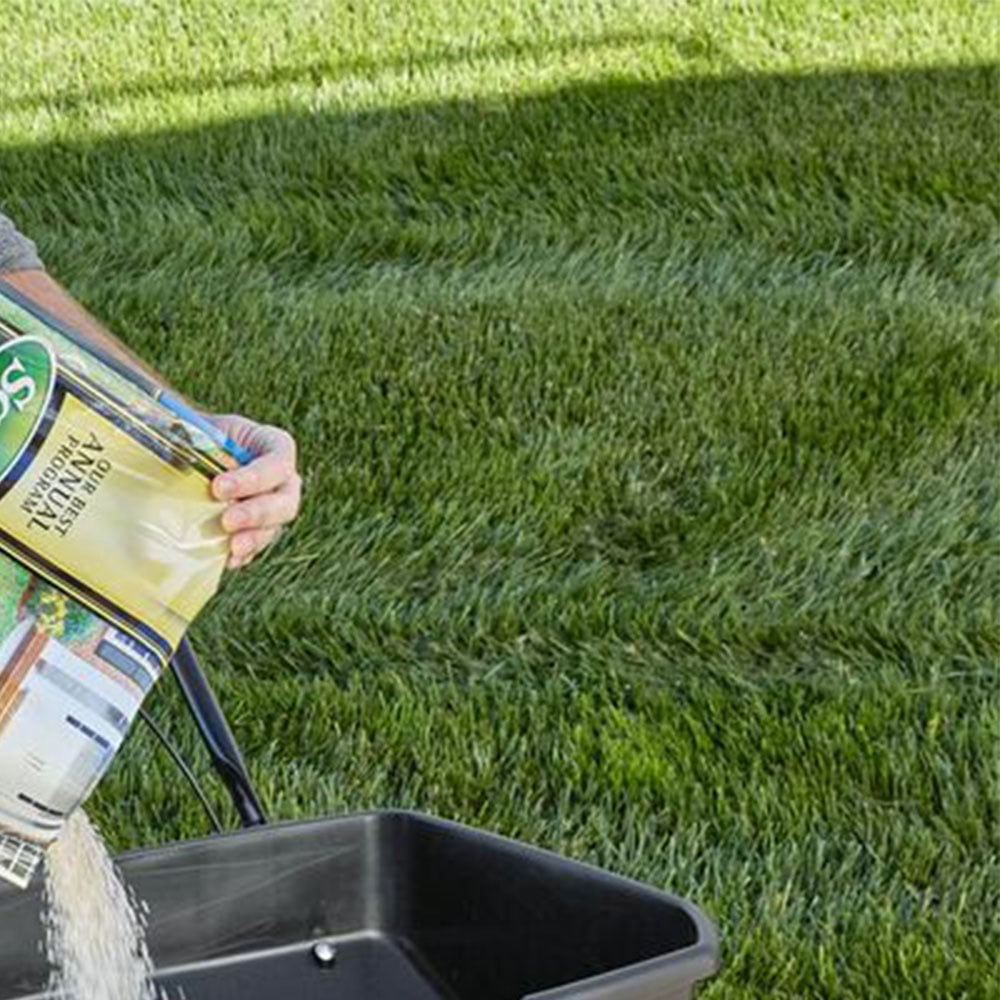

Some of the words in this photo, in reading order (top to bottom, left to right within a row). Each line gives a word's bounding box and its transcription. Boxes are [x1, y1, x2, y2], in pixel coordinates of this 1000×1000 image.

[19, 433, 79, 514] PROGRAM
[25, 430, 105, 534] ANNUAL
[80, 457, 111, 496] OUR
[52, 496, 86, 537] BEST
